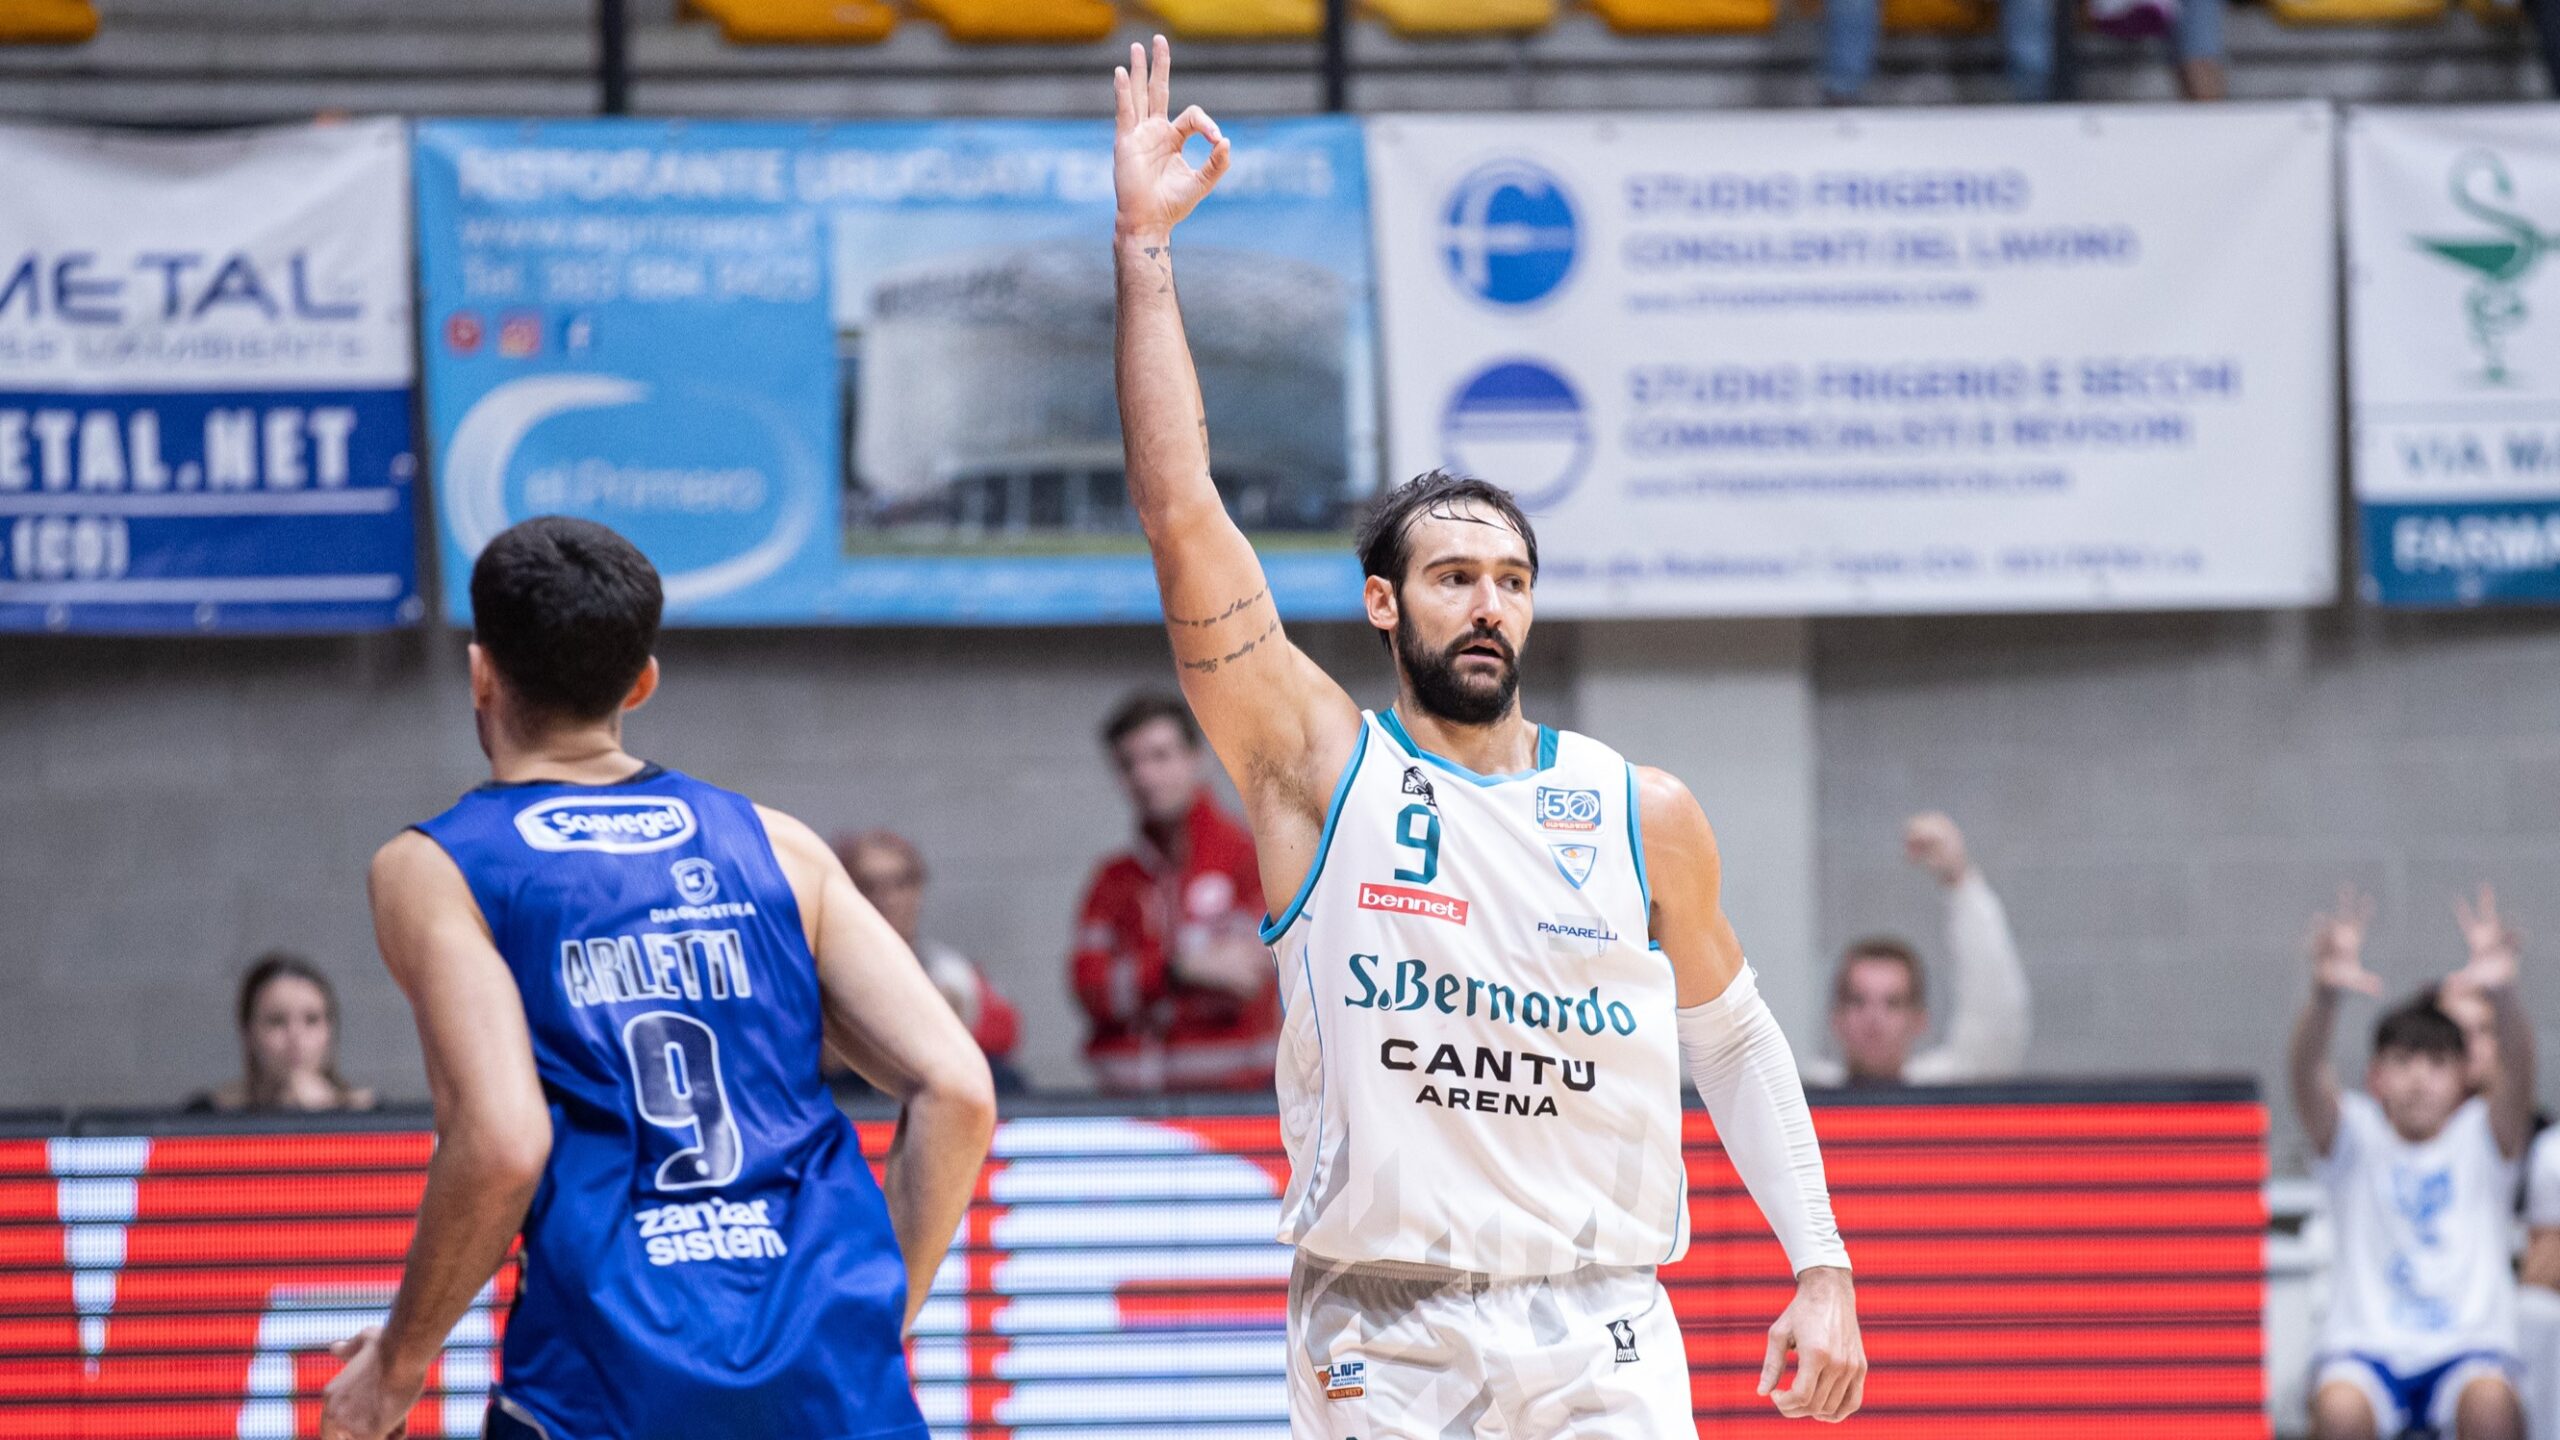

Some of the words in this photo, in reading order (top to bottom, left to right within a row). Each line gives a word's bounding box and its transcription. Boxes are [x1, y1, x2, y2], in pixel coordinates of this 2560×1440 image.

[1622, 174, 1799, 216] STUDIO
[1811, 170, 2028, 214] FRIGERIO
[1622, 231, 1878, 270] CONSULENTI
[1885, 229, 1962, 268] DEL
[1972, 226, 2136, 267] LAVORO
[1625, 367, 1801, 406] STUDIO
[1815, 363, 2028, 404] FRIGERIO
[2040, 361, 2067, 402] E
[2074, 358, 2240, 402] SECCHI
[2005, 410, 2191, 451] REVISORI
[551, 804, 685, 839] Soavegel
[1394, 803, 1441, 885] 9
[1362, 887, 1463, 920] bennet
[560, 929, 753, 1008] ARLETTI
[1345, 953, 1637, 1036] S.Bernardo
[622, 1010, 744, 1191] 9
[1415, 1084, 1559, 1117] ARENA
[646, 1224, 788, 1267] sistem
[1330, 1362, 1364, 1378] LNP
